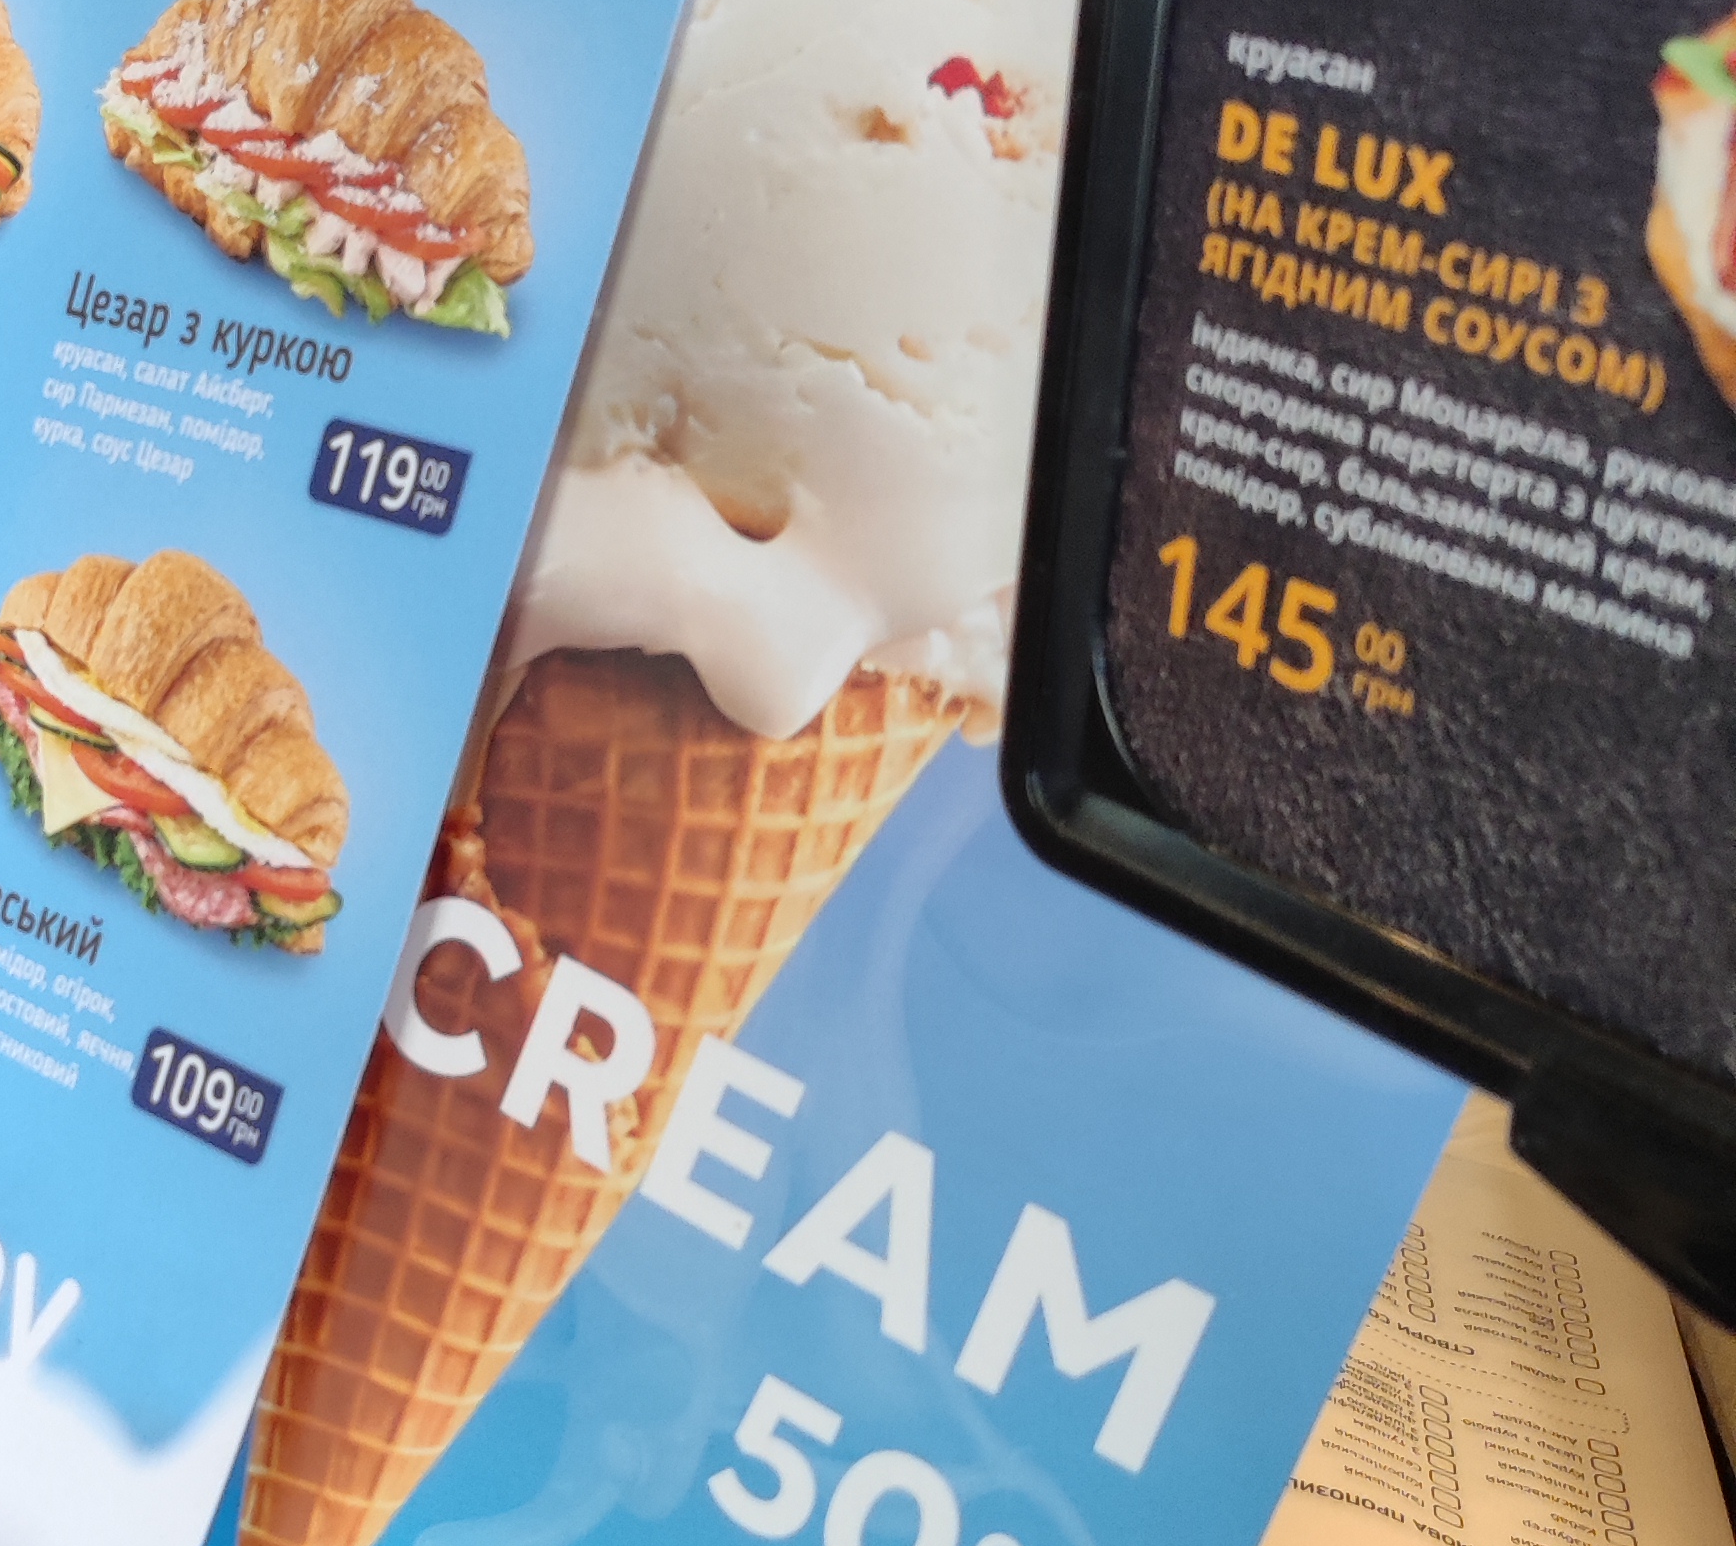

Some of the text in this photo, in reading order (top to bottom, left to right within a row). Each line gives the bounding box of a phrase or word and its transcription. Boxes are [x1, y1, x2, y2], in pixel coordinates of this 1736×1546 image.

[1228, 29, 1376, 95] круасан
[1215, 100, 1455, 216] DE LUX
[1207, 178, 1609, 329] (НА КРЕМ-СИРІ З
[66, 270, 354, 384] Цезар з куркою
[1200, 231, 1669, 415] ЯГІДНИМ СОУСОМ)
[53, 340, 128, 380] круасан,
[133, 360, 191, 394] салат
[1331, 363, 1396, 414] сир
[33, 414, 195, 486] курка, соус Цезар
[41, 376, 265, 461] сир Пармезан, помідор,
[1185, 363, 1364, 447] смородина
[1369, 424, 1559, 514] перетерта
[1561, 488, 1588, 521] з
[328, 430, 453, 514] 119 00
[412, 490, 448, 522] грн
[1180, 406, 1331, 489] крем-сир,
[1601, 554, 1715, 622] крем,
[1174, 449, 1308, 528] помідор,
[1540, 580, 1695, 660] малина
[1158, 535, 1408, 693] 145 00
[1352, 673, 1415, 716] грн
[52, 971, 117, 1024] огірок,
[151, 1042, 265, 1134] 109 00
[226, 1114, 260, 1149] грн
[381, 894, 1218, 1477] CREAM
[1397, 1322, 1475, 1356] СТВОРИ
